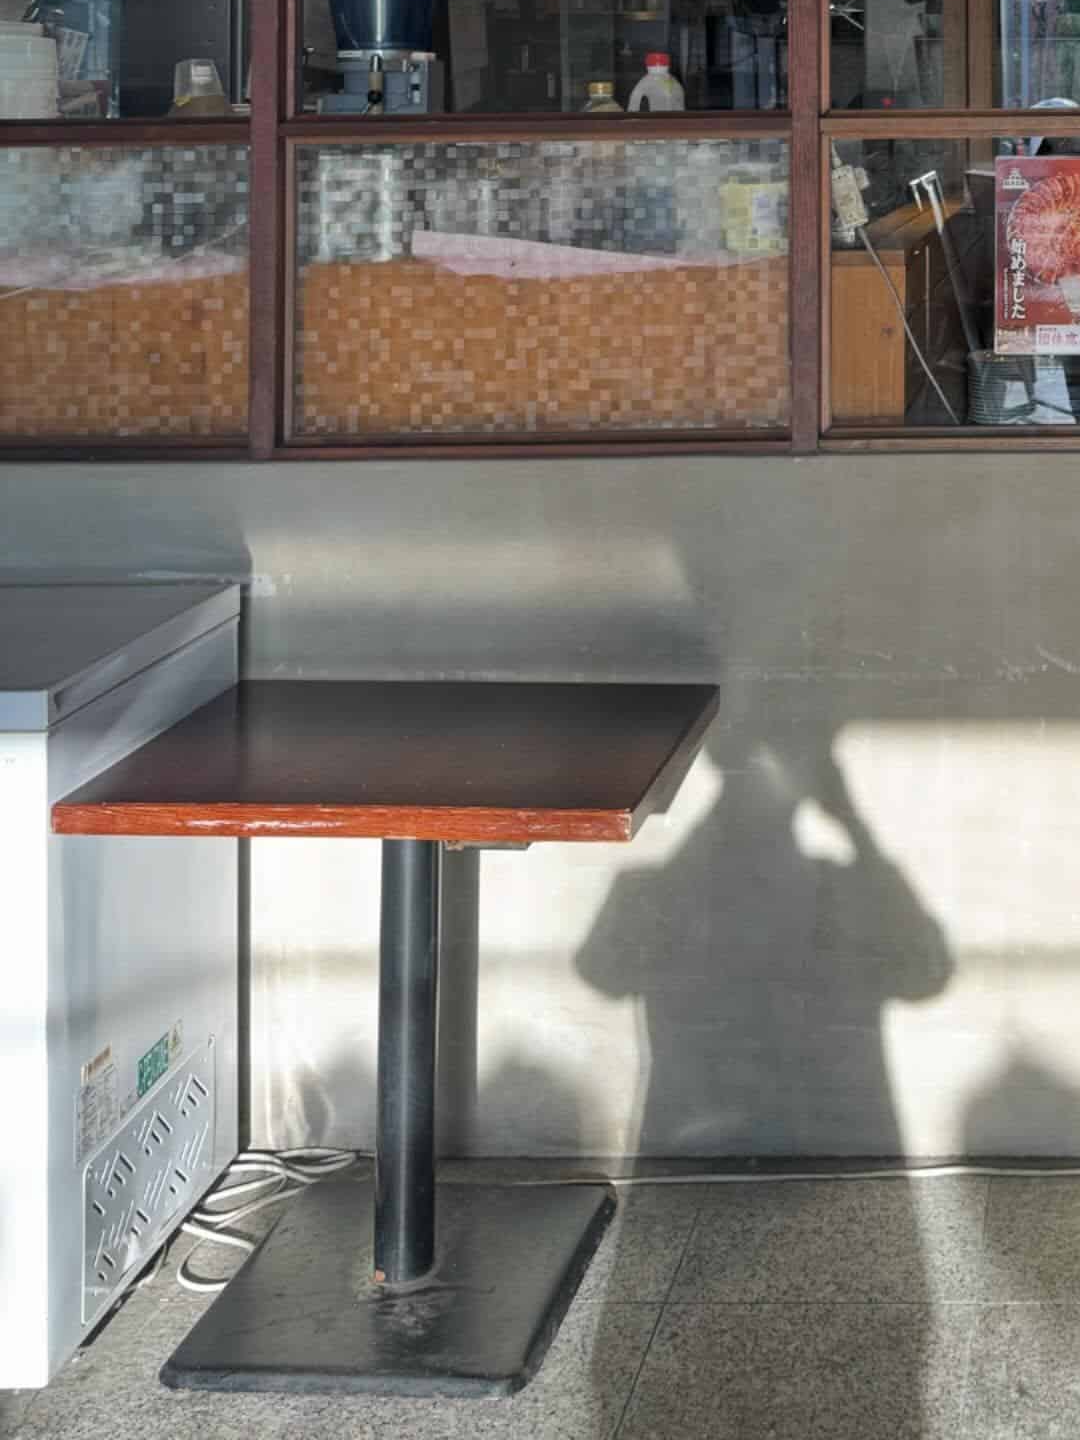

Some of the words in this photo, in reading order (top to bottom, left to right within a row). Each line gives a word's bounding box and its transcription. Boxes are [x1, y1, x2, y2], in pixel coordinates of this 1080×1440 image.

[1009, 238, 1027, 320] 始めました
